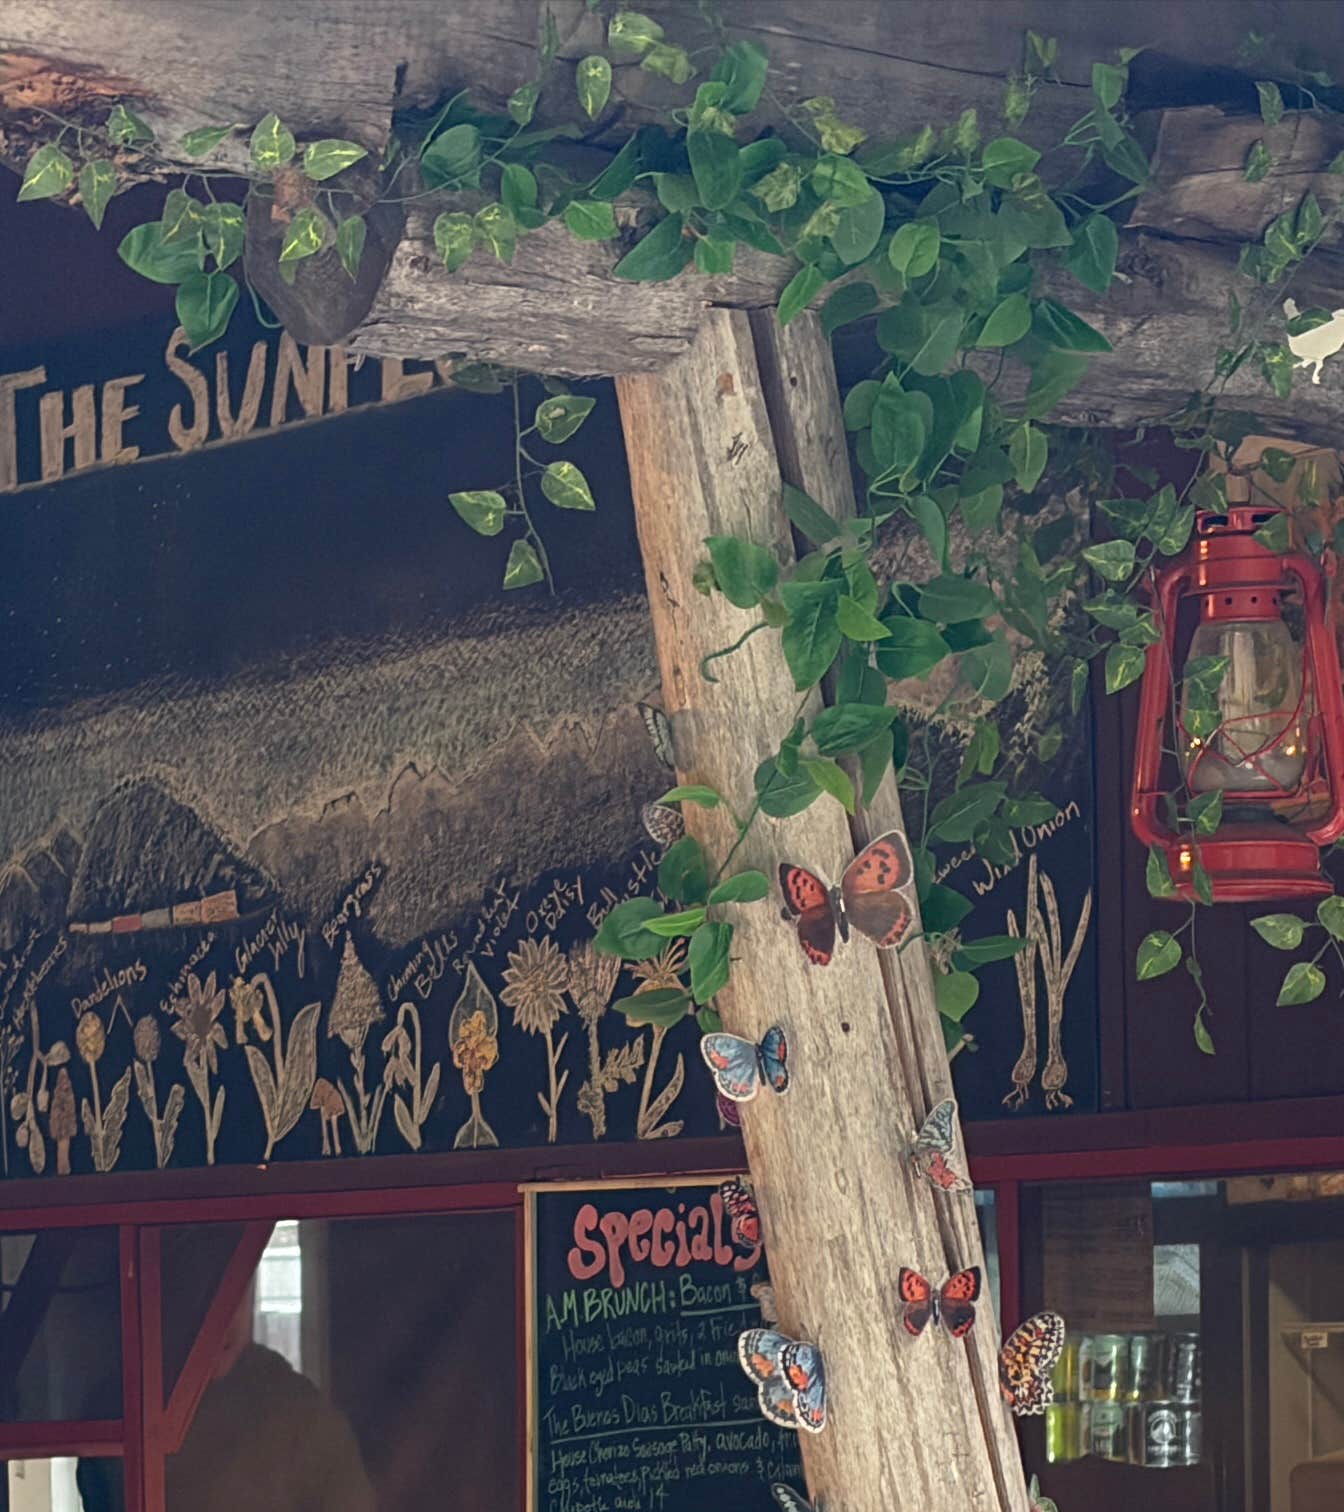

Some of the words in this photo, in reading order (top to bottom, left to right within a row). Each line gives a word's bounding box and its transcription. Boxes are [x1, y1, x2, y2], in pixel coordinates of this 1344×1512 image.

[1020, 800, 1081, 848] Onion
[70, 957, 147, 1019] Dandelions
[680, 1272, 733, 1307] Bacon
